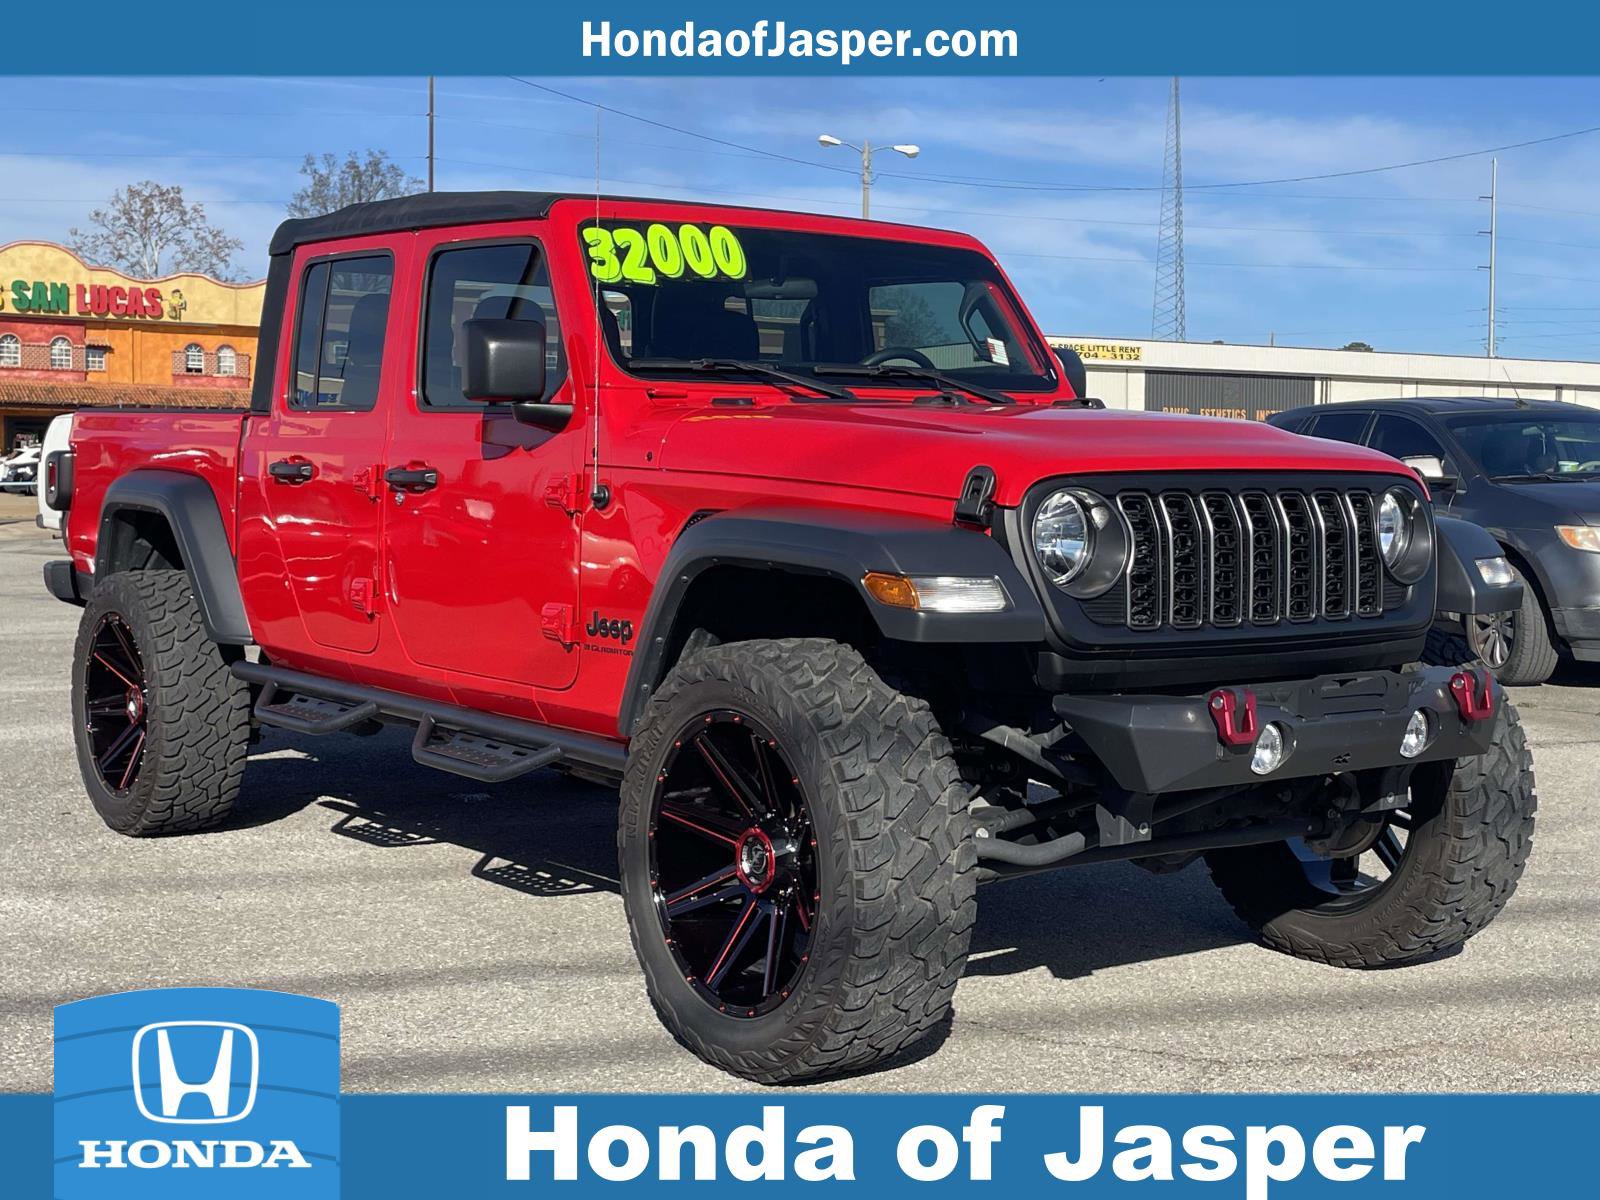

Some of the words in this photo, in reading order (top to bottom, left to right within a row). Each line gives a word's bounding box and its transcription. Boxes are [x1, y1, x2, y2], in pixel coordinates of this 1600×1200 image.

[582, 223, 747, 285] 32000
[11, 280, 70, 314] SAN
[76, 283, 164, 319] LUCAS
[1087, 344, 1116, 353] LITTLE
[1118, 345, 1141, 354] RENT
[1110, 352, 1141, 361] 3132
[1199, 407, 1247, 420] ESTHETICS
[586, 610, 633, 645] Jeep
